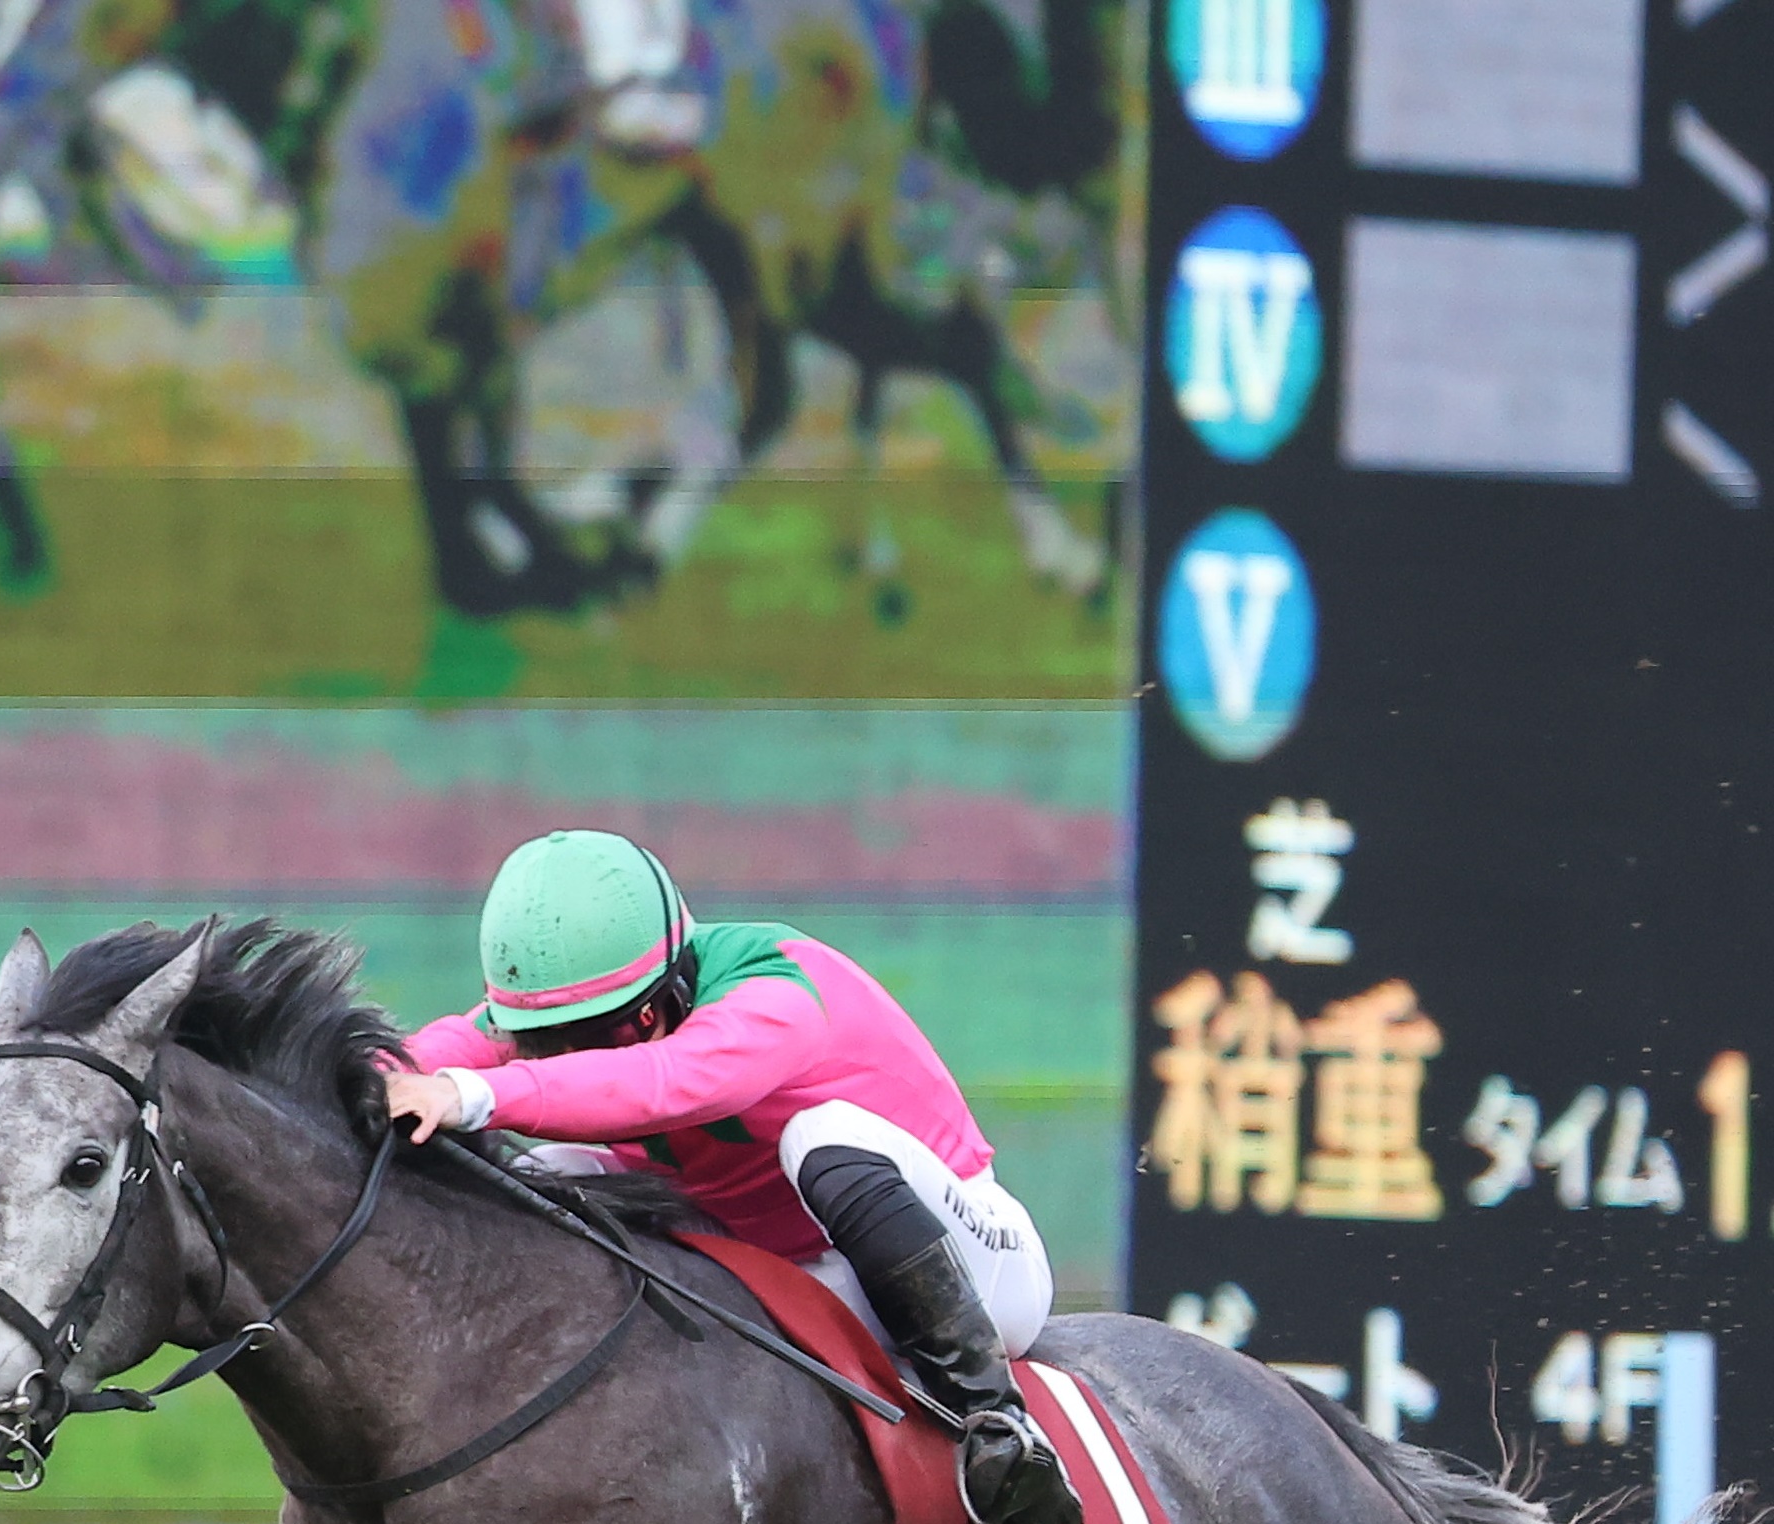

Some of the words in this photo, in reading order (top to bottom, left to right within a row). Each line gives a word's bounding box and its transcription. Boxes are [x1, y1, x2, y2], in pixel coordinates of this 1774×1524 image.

[1183, 550, 1292, 723] V
[1243, 797, 1355, 965] 芝
[1152, 969, 1445, 1222] 稍重
[1464, 1074, 1685, 1214] タイム
[1532, 1330, 1664, 1446] 4F
